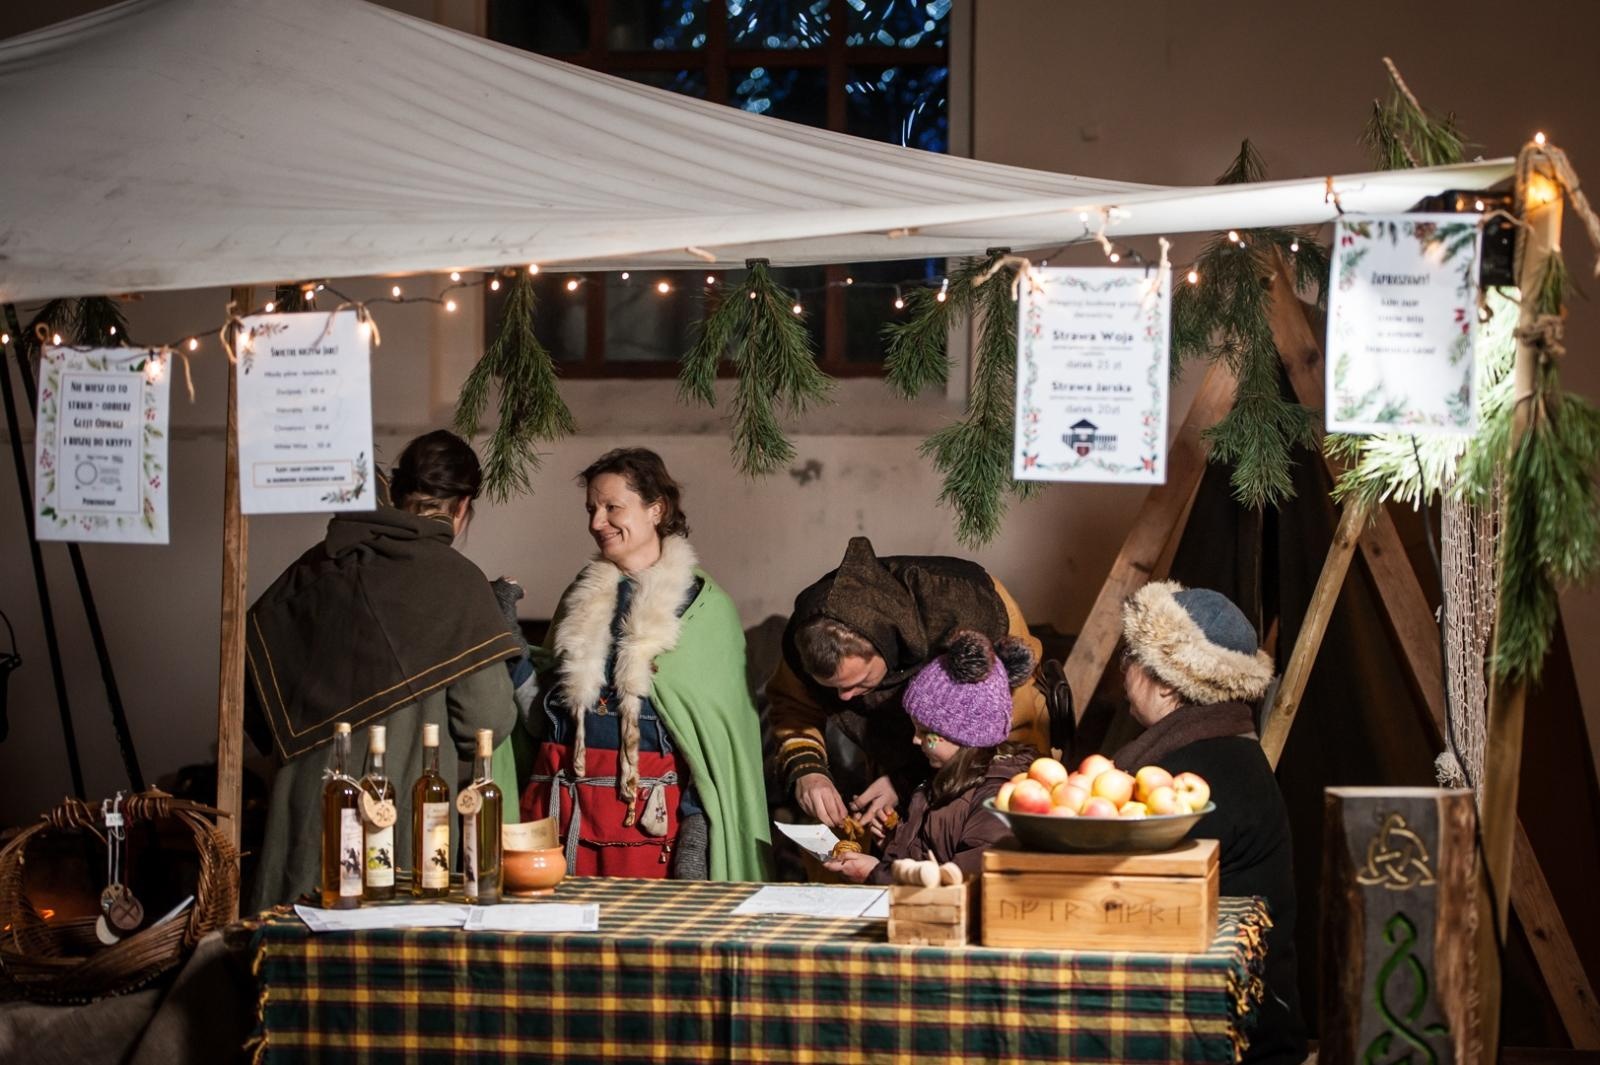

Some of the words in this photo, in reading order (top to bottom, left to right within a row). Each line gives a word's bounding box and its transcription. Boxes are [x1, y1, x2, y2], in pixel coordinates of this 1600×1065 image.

[1053, 330, 1096, 341] Strawa
[1101, 331, 1134, 344] Woja
[71, 382, 82, 392] NIE
[106, 383, 116, 393] CO
[118, 383, 128, 394] TO
[1052, 382, 1093, 392] Strawa
